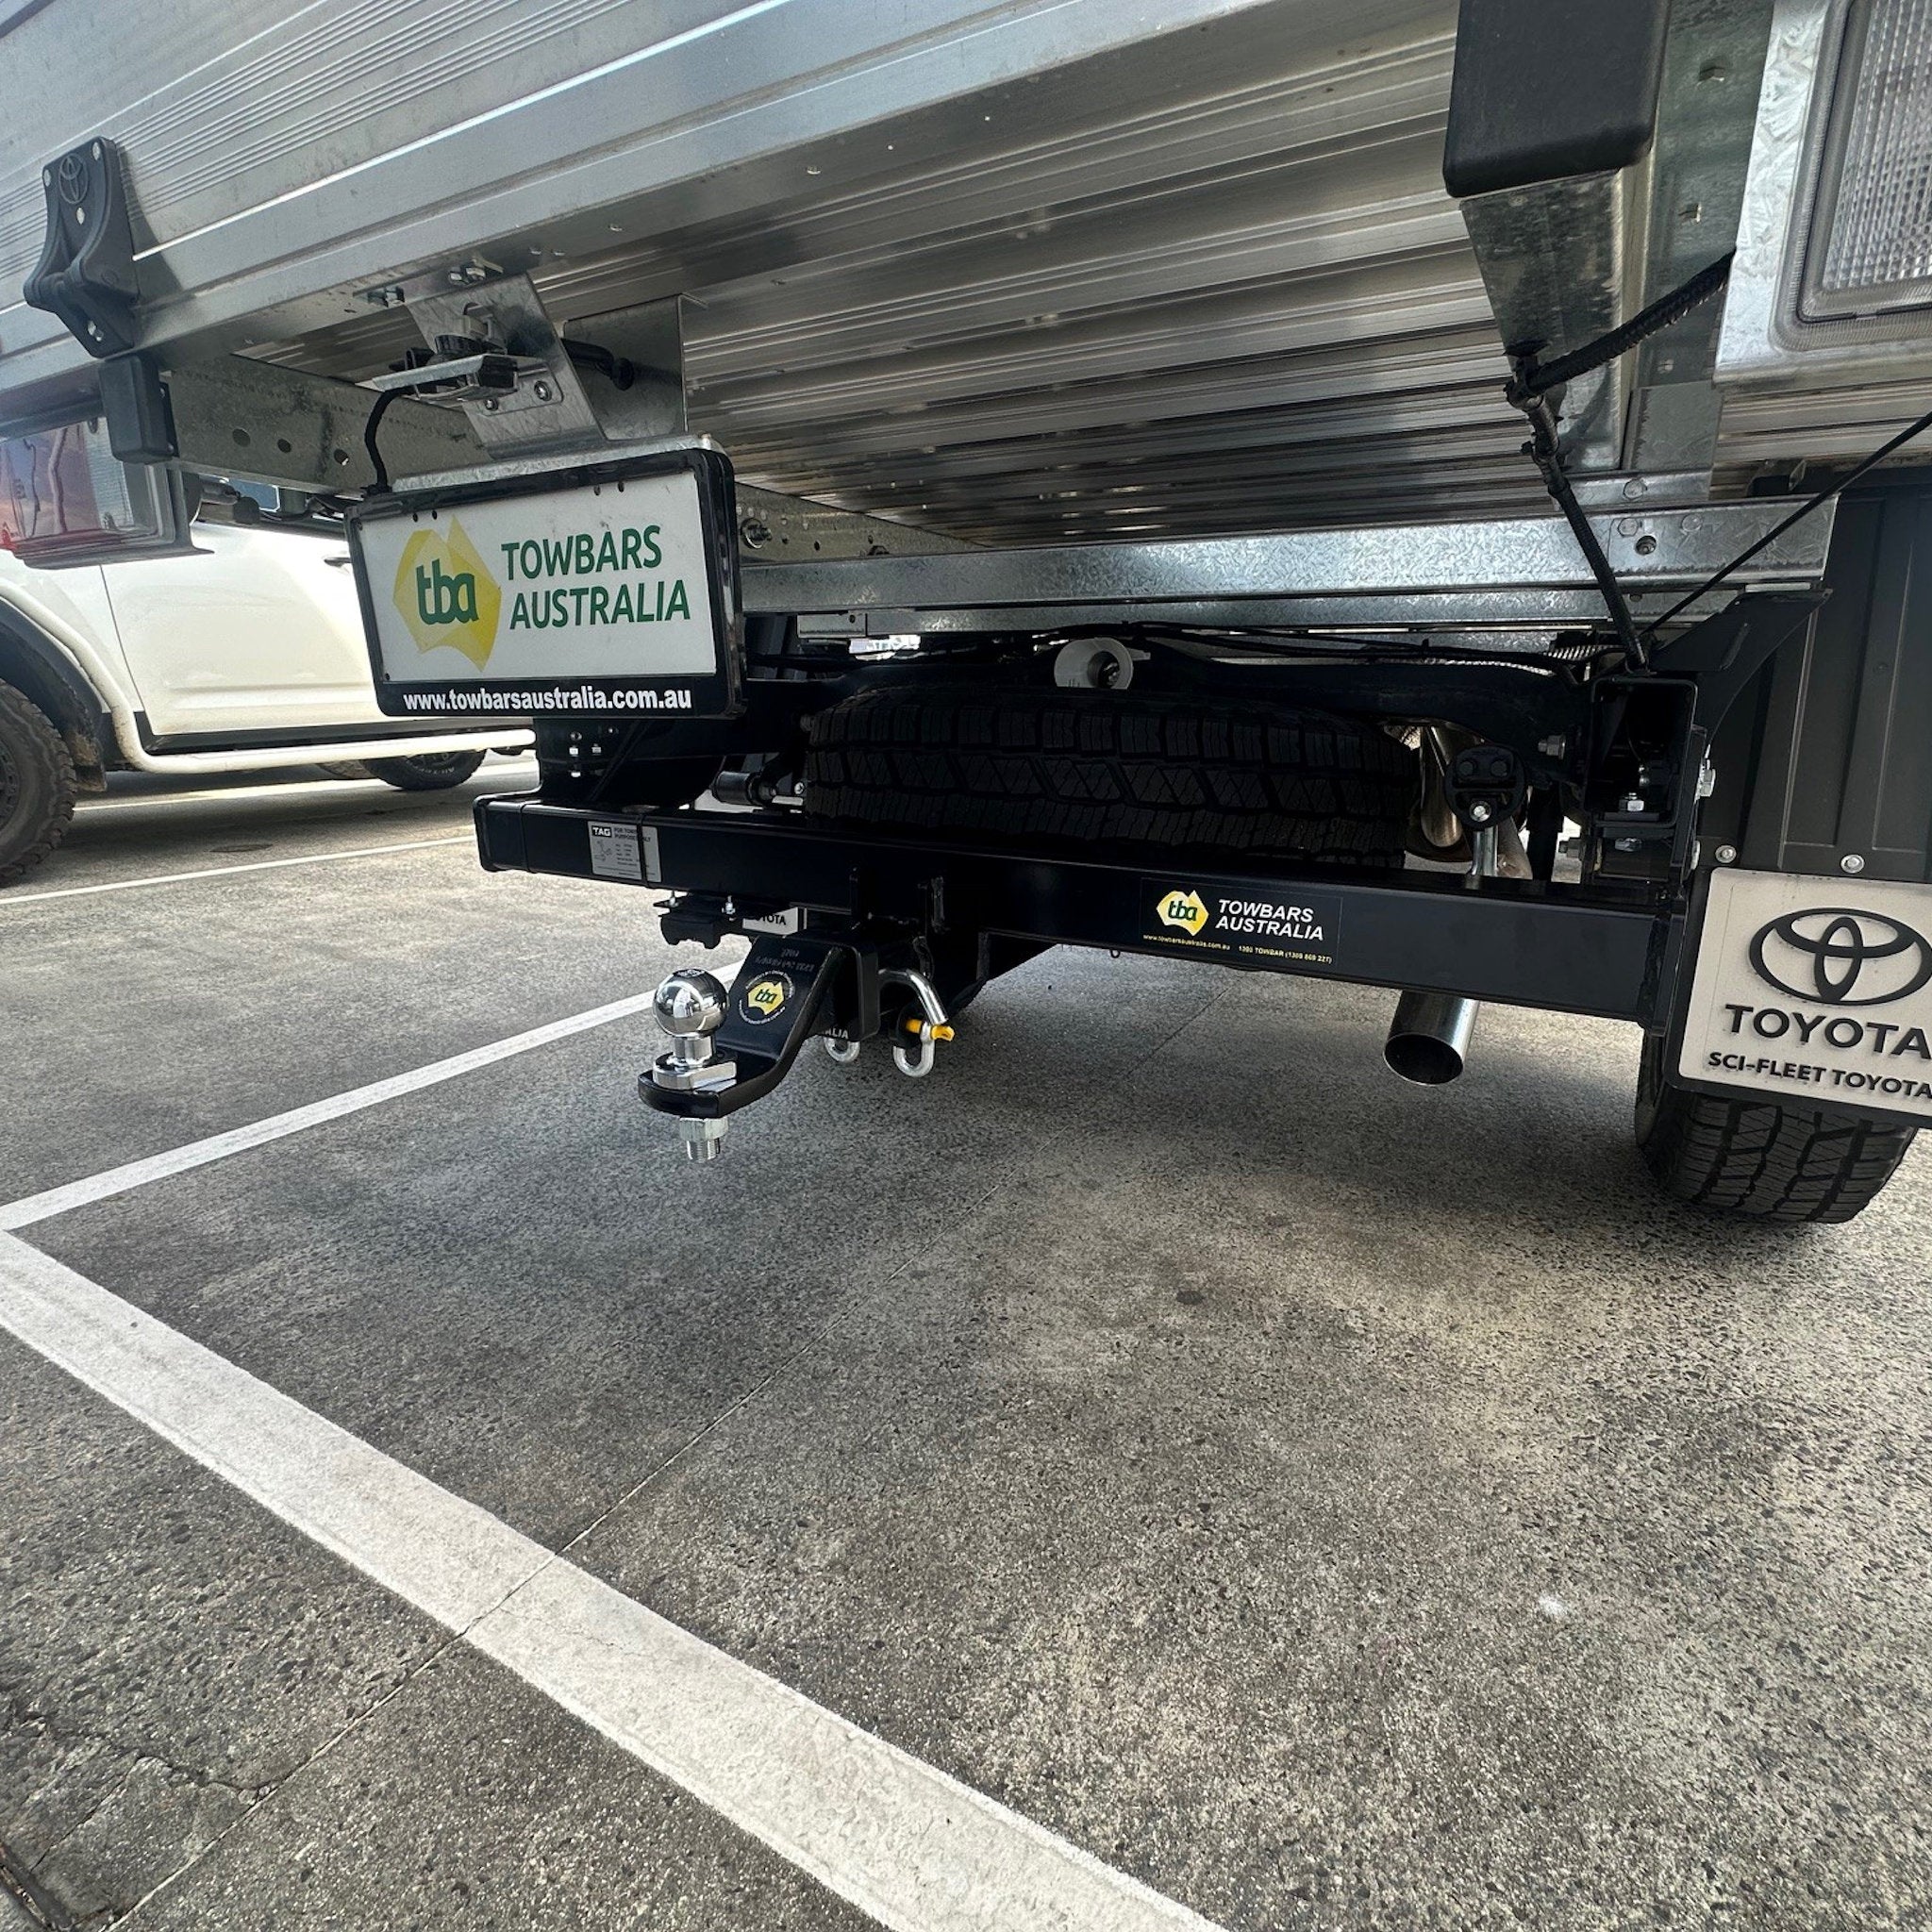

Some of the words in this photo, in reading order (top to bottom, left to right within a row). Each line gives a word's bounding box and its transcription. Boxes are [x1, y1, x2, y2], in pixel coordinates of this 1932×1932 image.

[501, 525, 662, 580] TOWBARS
[416, 558, 478, 625] tba
[509, 579, 691, 630] AUSTRALIA
[403, 685, 692, 711] www.towbarsaustralia.com.au
[592, 826, 611, 838] TAG
[1168, 900, 1198, 922] tba
[1218, 899, 1314, 923] TOWBARS
[1215, 915, 1324, 941] AUSTRALIA
[1255, 946, 1284, 958] TOWBAR
[1724, 1004, 1932, 1060] TOYOTA
[1707, 1051, 1827, 1083] SCI-FLEET
[1832, 1069, 1932, 1100] TOYOTA
